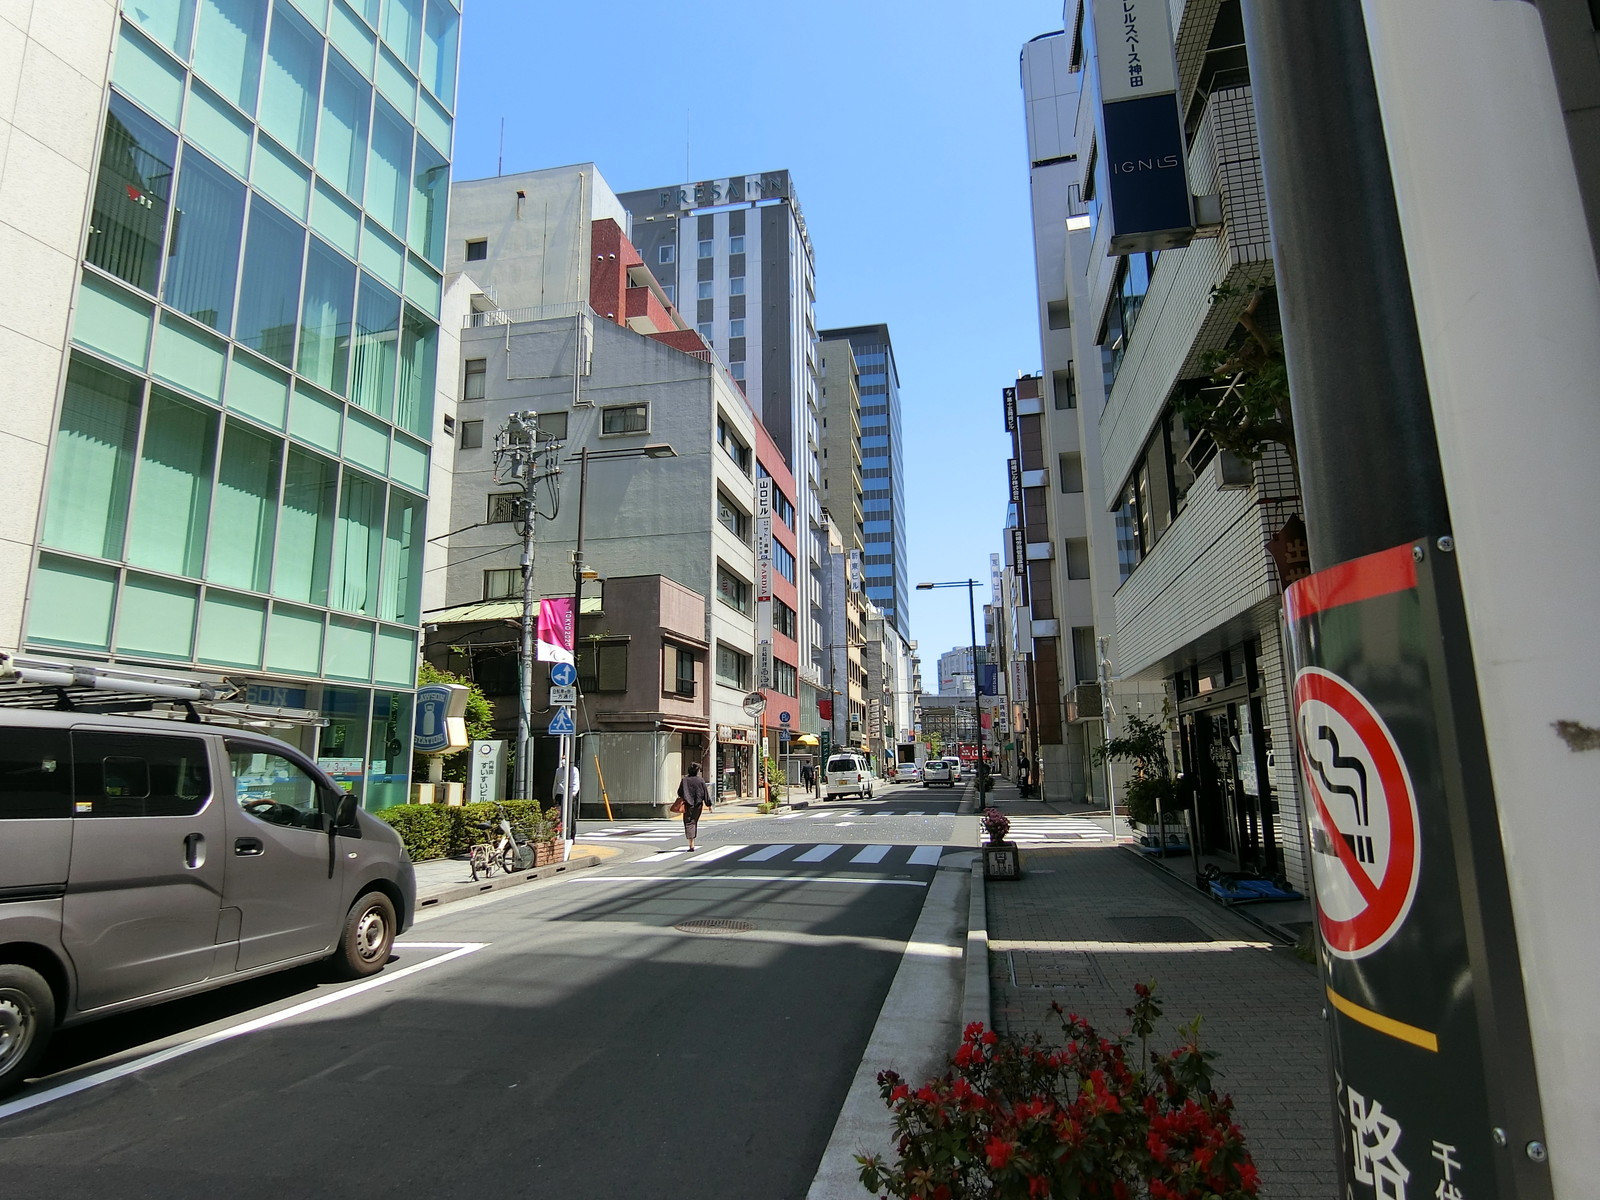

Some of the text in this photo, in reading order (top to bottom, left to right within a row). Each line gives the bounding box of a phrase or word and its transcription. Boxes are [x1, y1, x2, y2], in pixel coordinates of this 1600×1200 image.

[1122, 0, 1144, 88] レルスペース神田
[1114, 154, 1178, 175] IGNIS
[1347, 1085, 1410, 1200] 路
